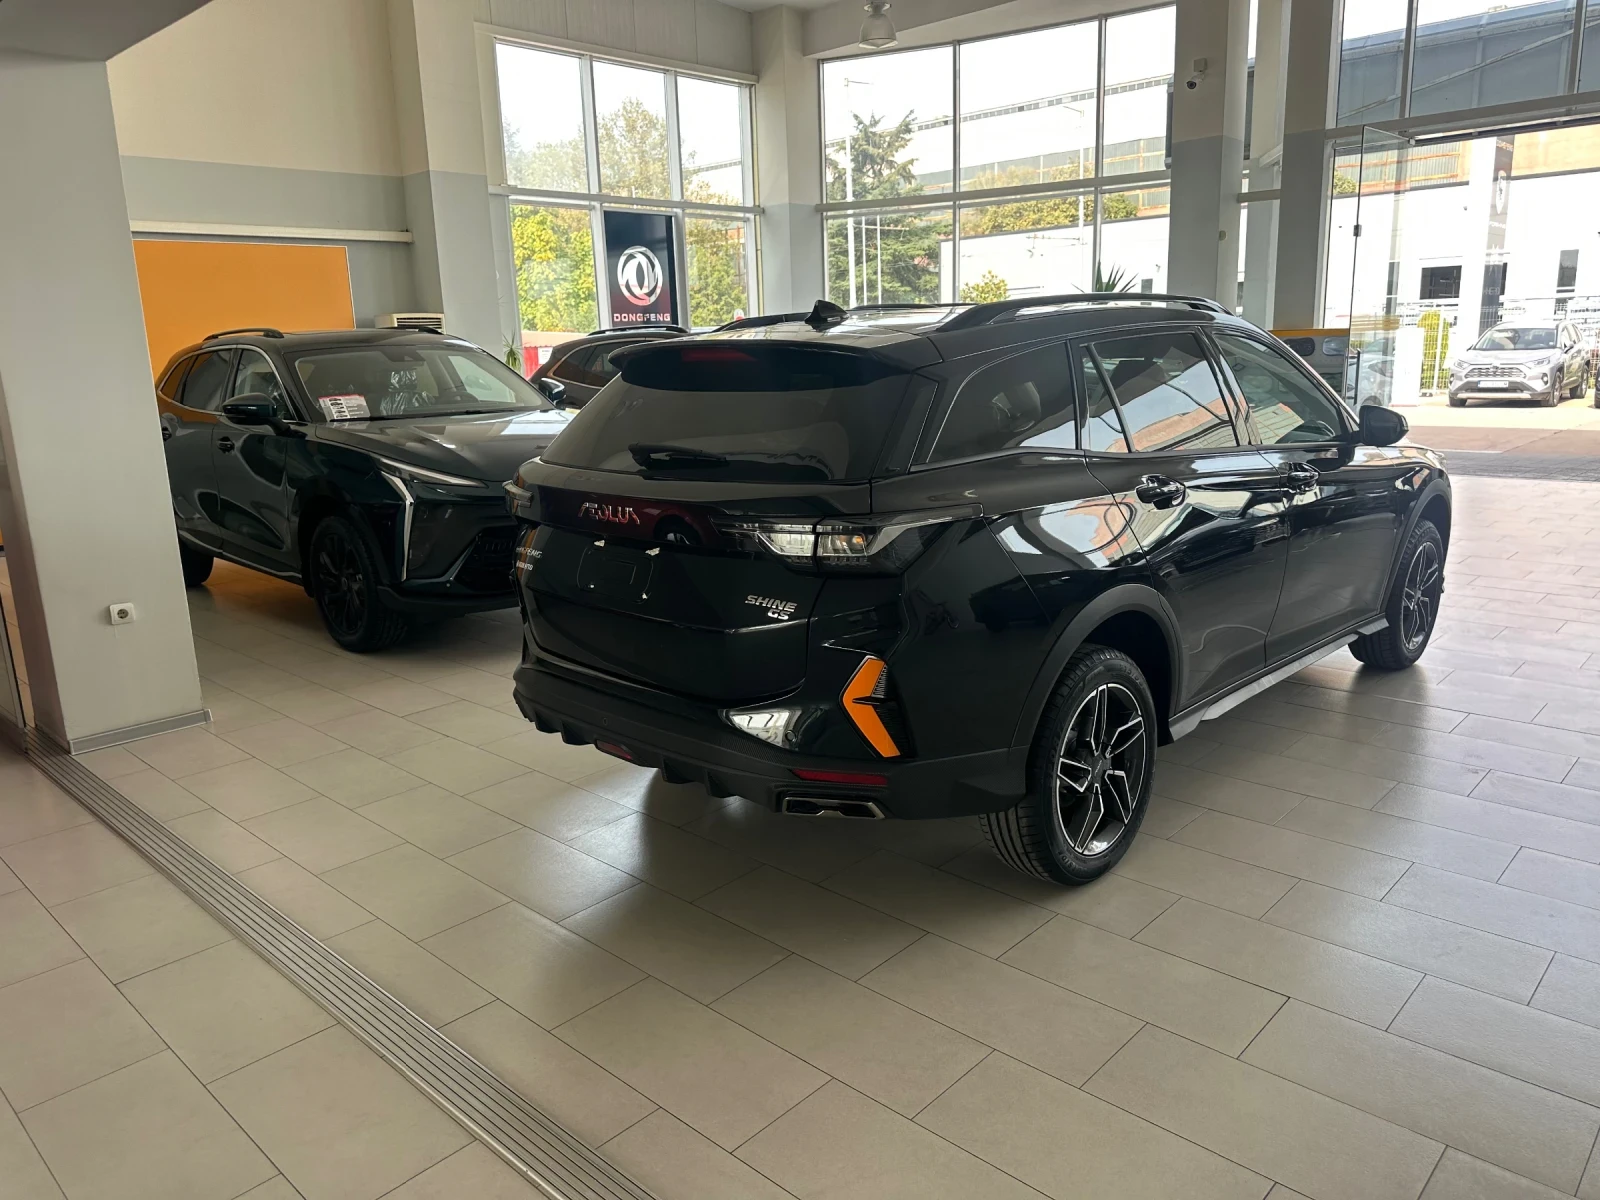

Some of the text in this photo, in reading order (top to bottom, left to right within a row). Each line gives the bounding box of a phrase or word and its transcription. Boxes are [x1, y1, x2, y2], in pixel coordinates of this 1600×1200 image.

[613, 313, 671, 322] DONGFENG
[745, 594, 798, 612] SHINE
[767, 608, 791, 620] GS
